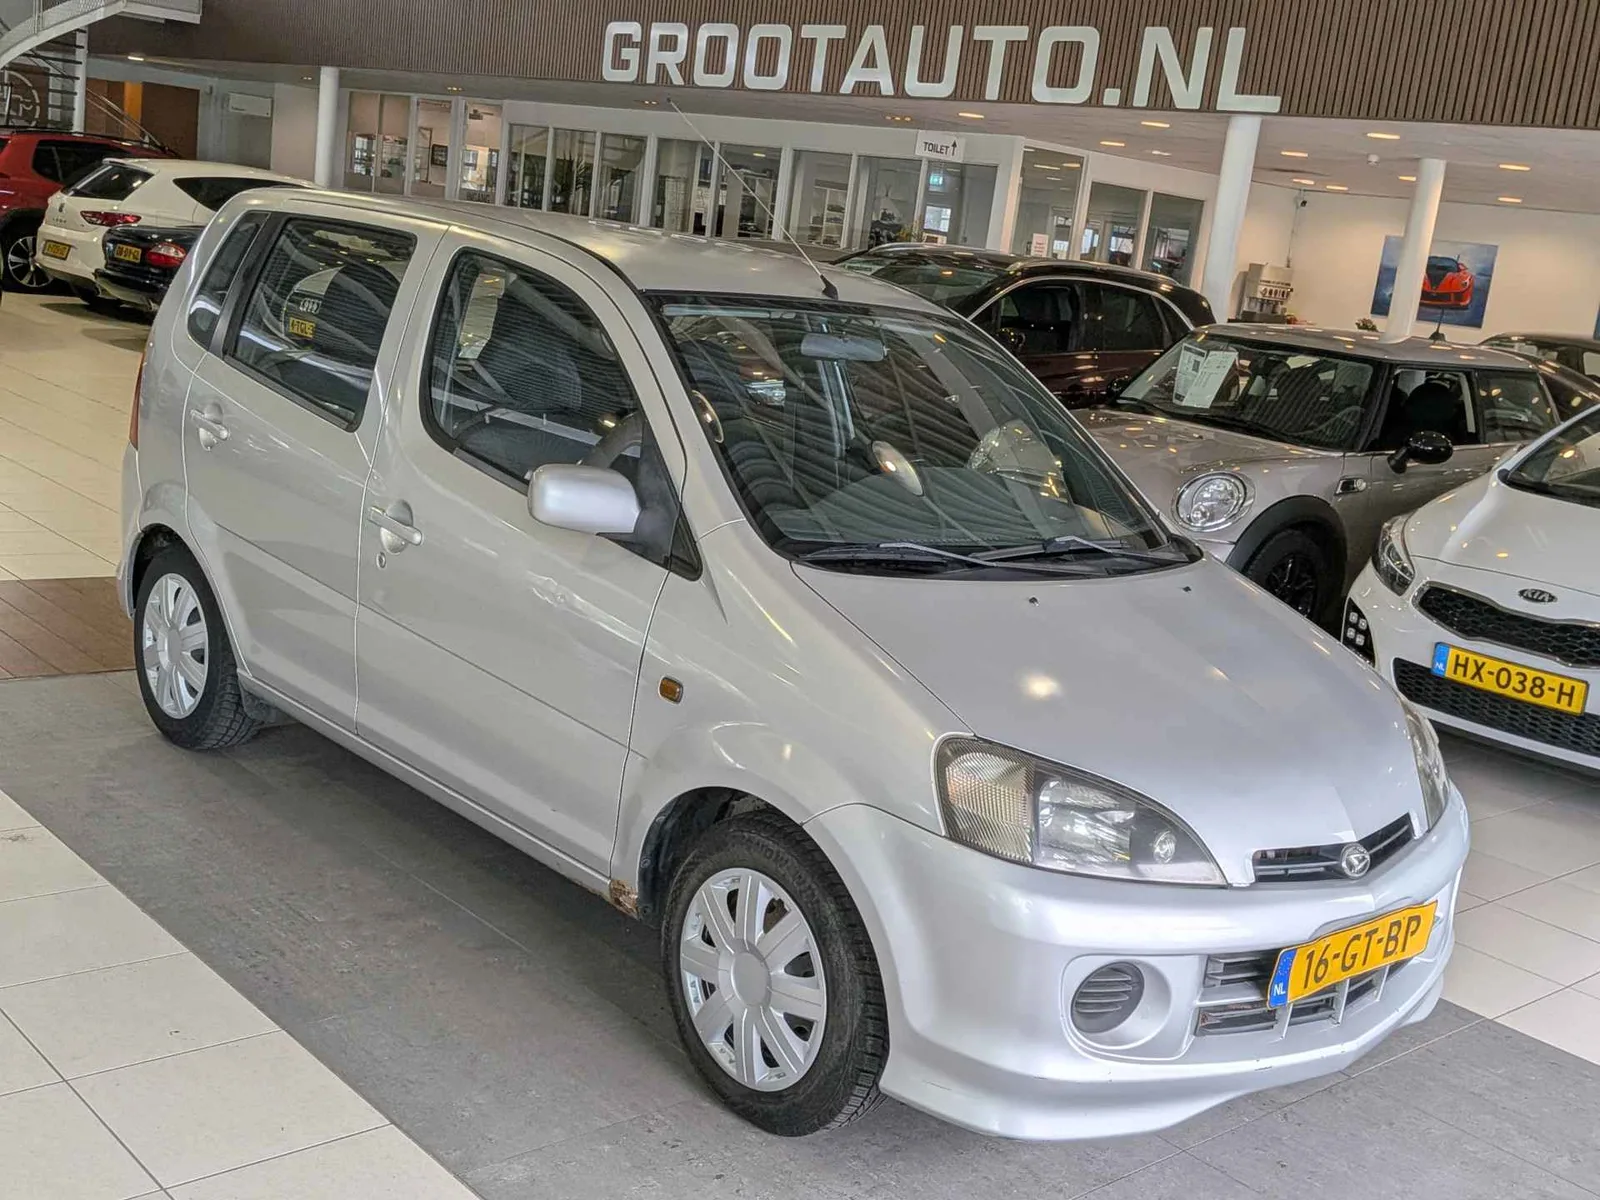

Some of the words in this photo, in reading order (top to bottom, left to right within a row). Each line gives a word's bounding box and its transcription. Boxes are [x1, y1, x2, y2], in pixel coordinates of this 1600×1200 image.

[602, 21, 1281, 113] GROOTAUTO.NL
[923, 141, 950, 155] TOILET
[1522, 588, 1553, 603] KIA
[1435, 661, 1445, 671] NL
[1452, 654, 1576, 707] HX-038-H
[1303, 914, 1422, 989] 16-GT-BP
[1273, 983, 1286, 996] NL
